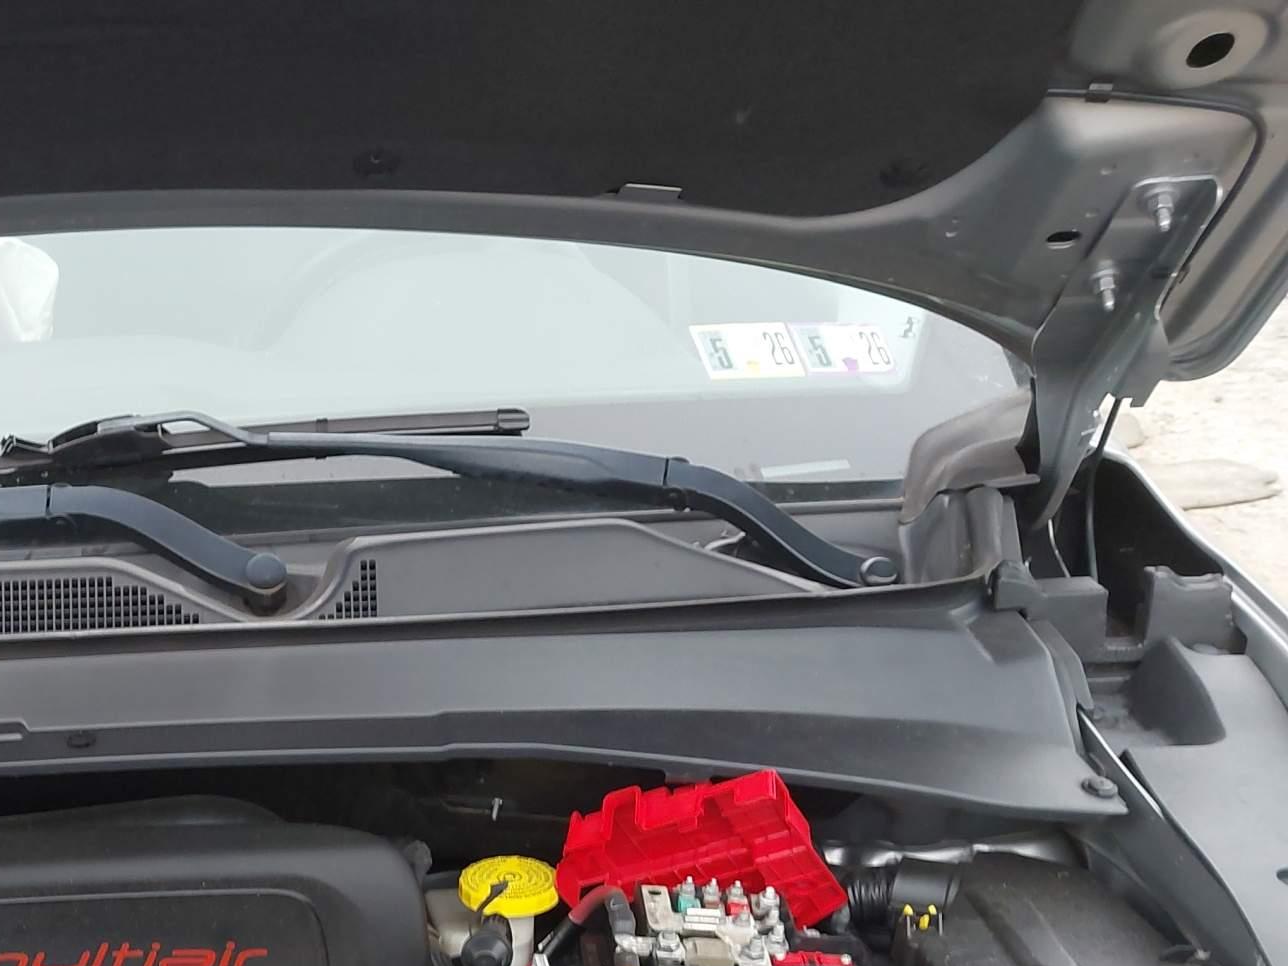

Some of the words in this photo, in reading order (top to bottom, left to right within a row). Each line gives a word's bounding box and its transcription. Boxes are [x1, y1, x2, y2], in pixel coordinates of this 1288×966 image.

[709, 338, 733, 369] 5
[762, 331, 795, 366] 26
[808, 335, 833, 367] 5
[858, 331, 891, 366] 26
